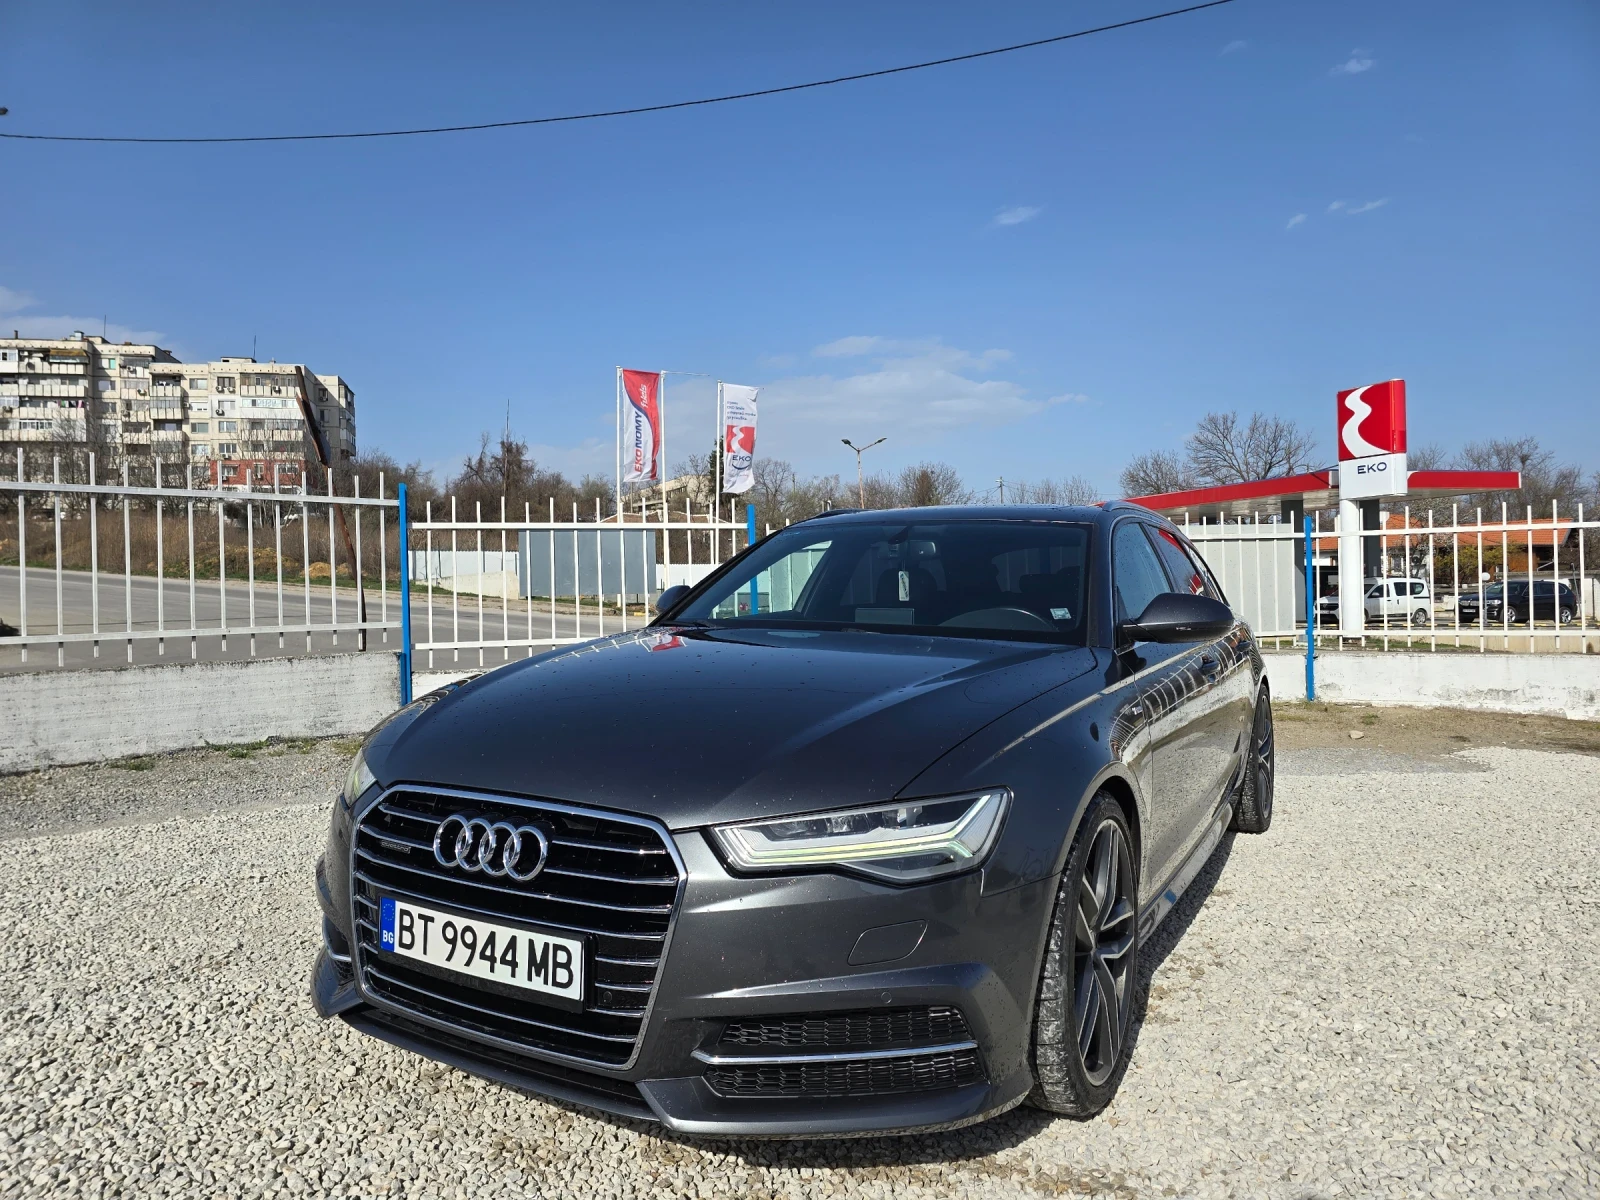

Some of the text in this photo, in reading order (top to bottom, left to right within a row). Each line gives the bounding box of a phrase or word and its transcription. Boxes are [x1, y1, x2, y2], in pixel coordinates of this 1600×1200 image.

[634, 411, 643, 473] EKONOMY
[1357, 462, 1387, 474] EKO
[383, 930, 394, 944] BG
[398, 908, 574, 989] BT 9944 MB
